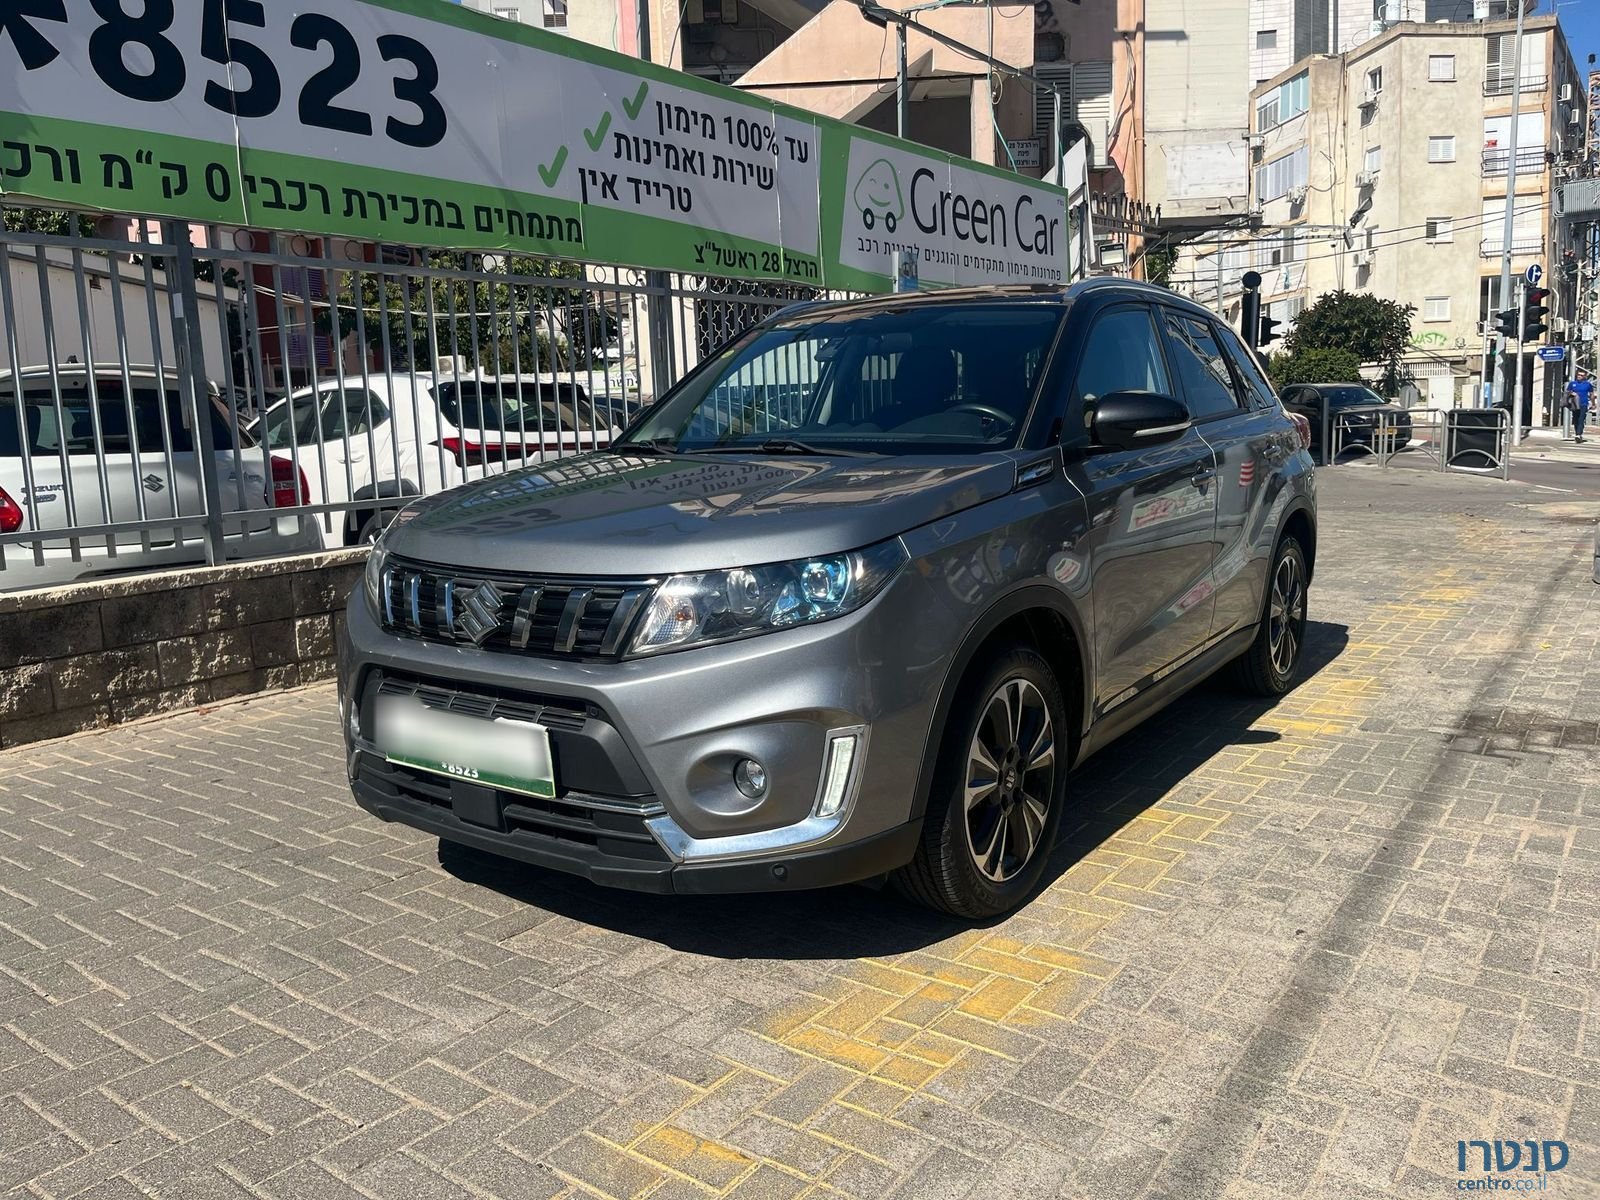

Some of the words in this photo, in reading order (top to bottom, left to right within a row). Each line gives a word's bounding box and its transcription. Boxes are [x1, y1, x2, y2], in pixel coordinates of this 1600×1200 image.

[656, 101, 716, 140] מימון
[724, 116, 780, 156] 100%
[0, 140, 81, 184] ורכ
[613, 132, 705, 176] ואמינות
[784, 136, 809, 163] עד
[205, 162, 231, 202] 0
[578, 167, 619, 204] אין
[713, 155, 774, 190] שירות
[244, 175, 331, 215] רכבי
[342, 187, 465, 230] במכירת
[626, 176, 692, 213] טרייד
[910, 167, 1007, 248] Green
[1015, 195, 1059, 257] Car
[474, 205, 583, 243] מתמחים
[762, 251, 780, 272] 28
[858, 237, 879, 253] רכב
[924, 247, 960, 267] והוגנים
[784, 252, 818, 277] הרצל
[964, 254, 1004, 274] מתקדמים
[1006, 259, 1029, 277] מימון
[1031, 264, 1062, 281] פתרונות
